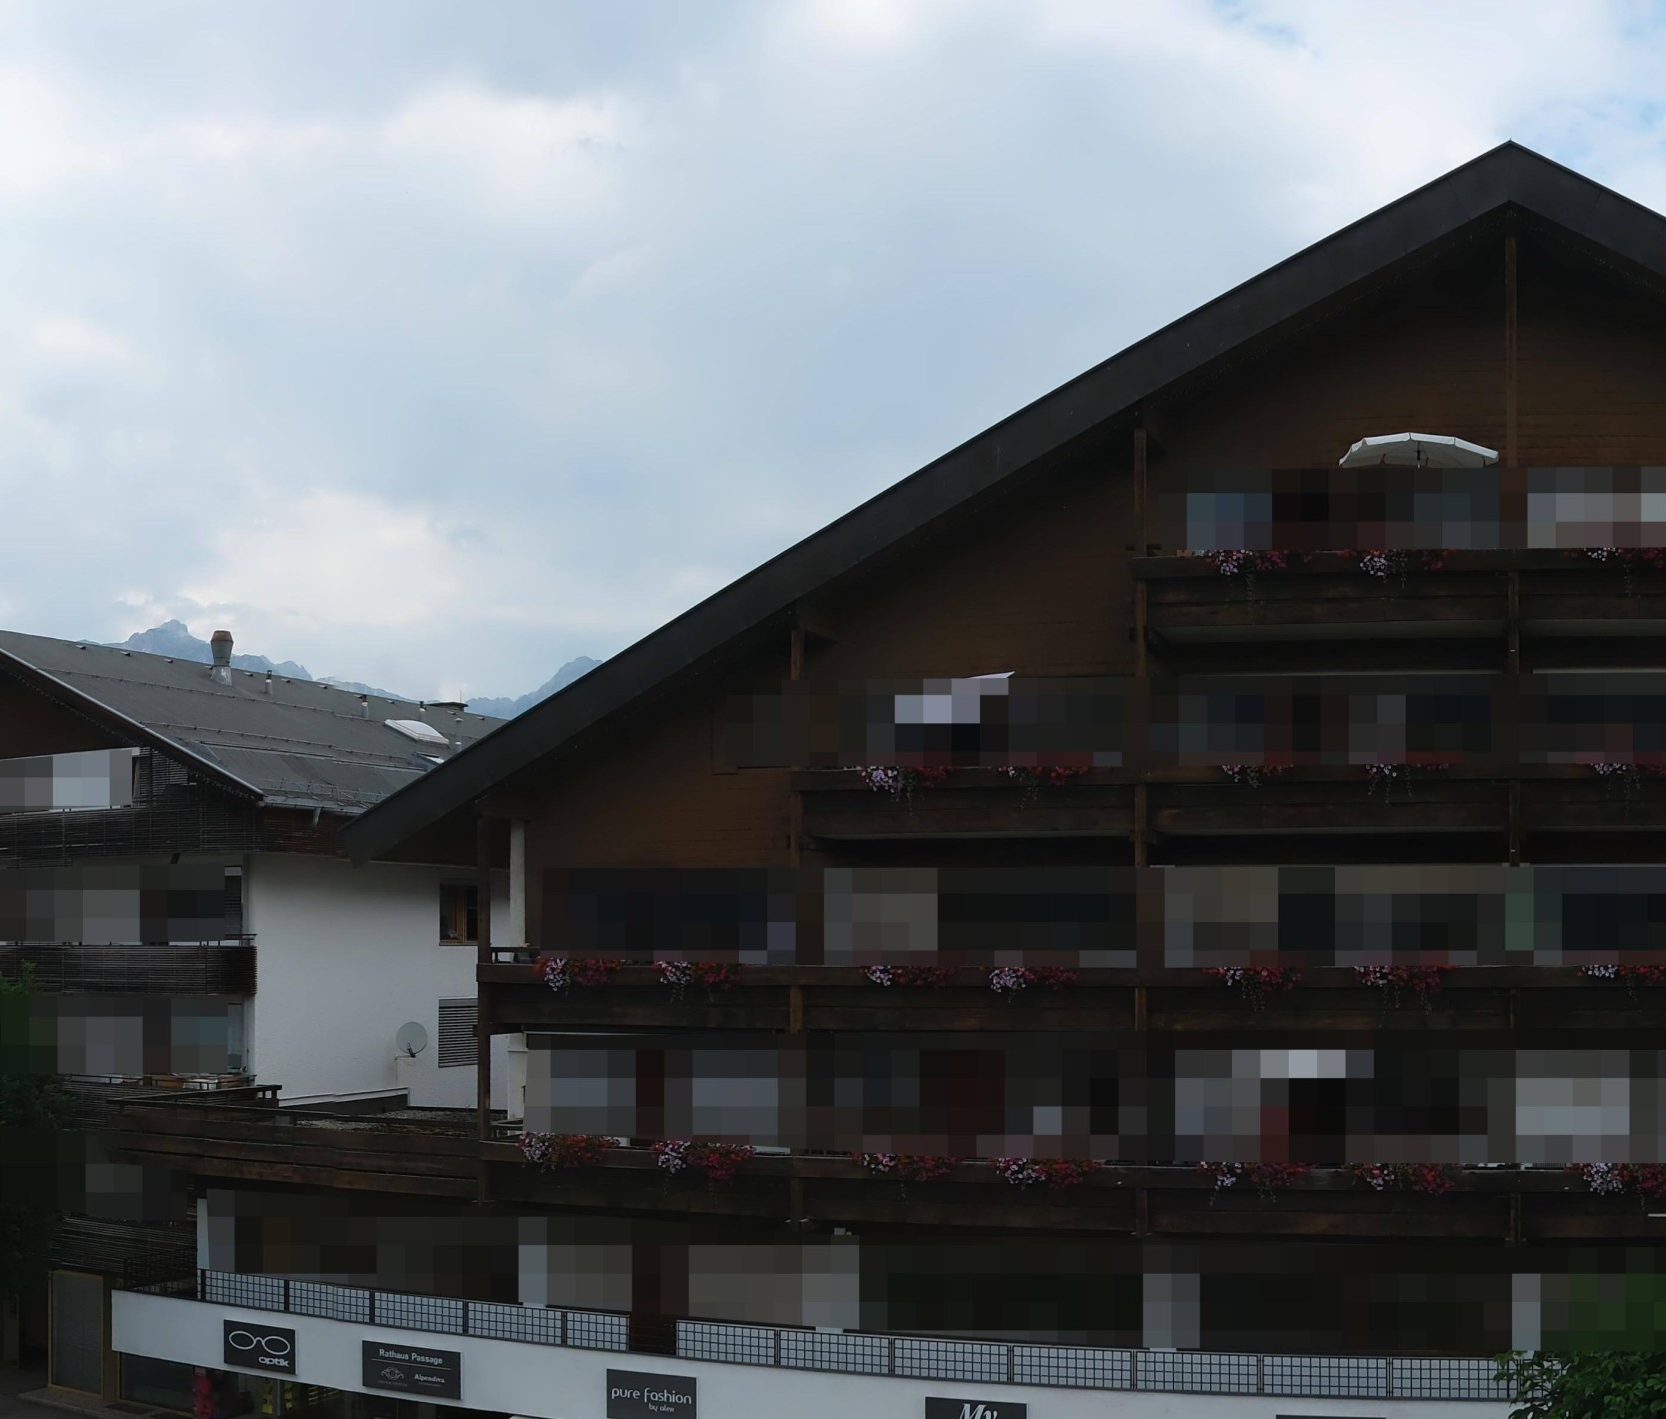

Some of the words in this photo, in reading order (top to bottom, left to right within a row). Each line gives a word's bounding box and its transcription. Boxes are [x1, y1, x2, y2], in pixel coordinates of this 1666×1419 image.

[258, 1356, 290, 1368] optik
[379, 1349, 410, 1361] Rathaus
[411, 1352, 444, 1366] Passage
[611, 1386, 640, 1402] pure
[644, 1388, 692, 1405] fashion
[648, 1403, 658, 1413] by
